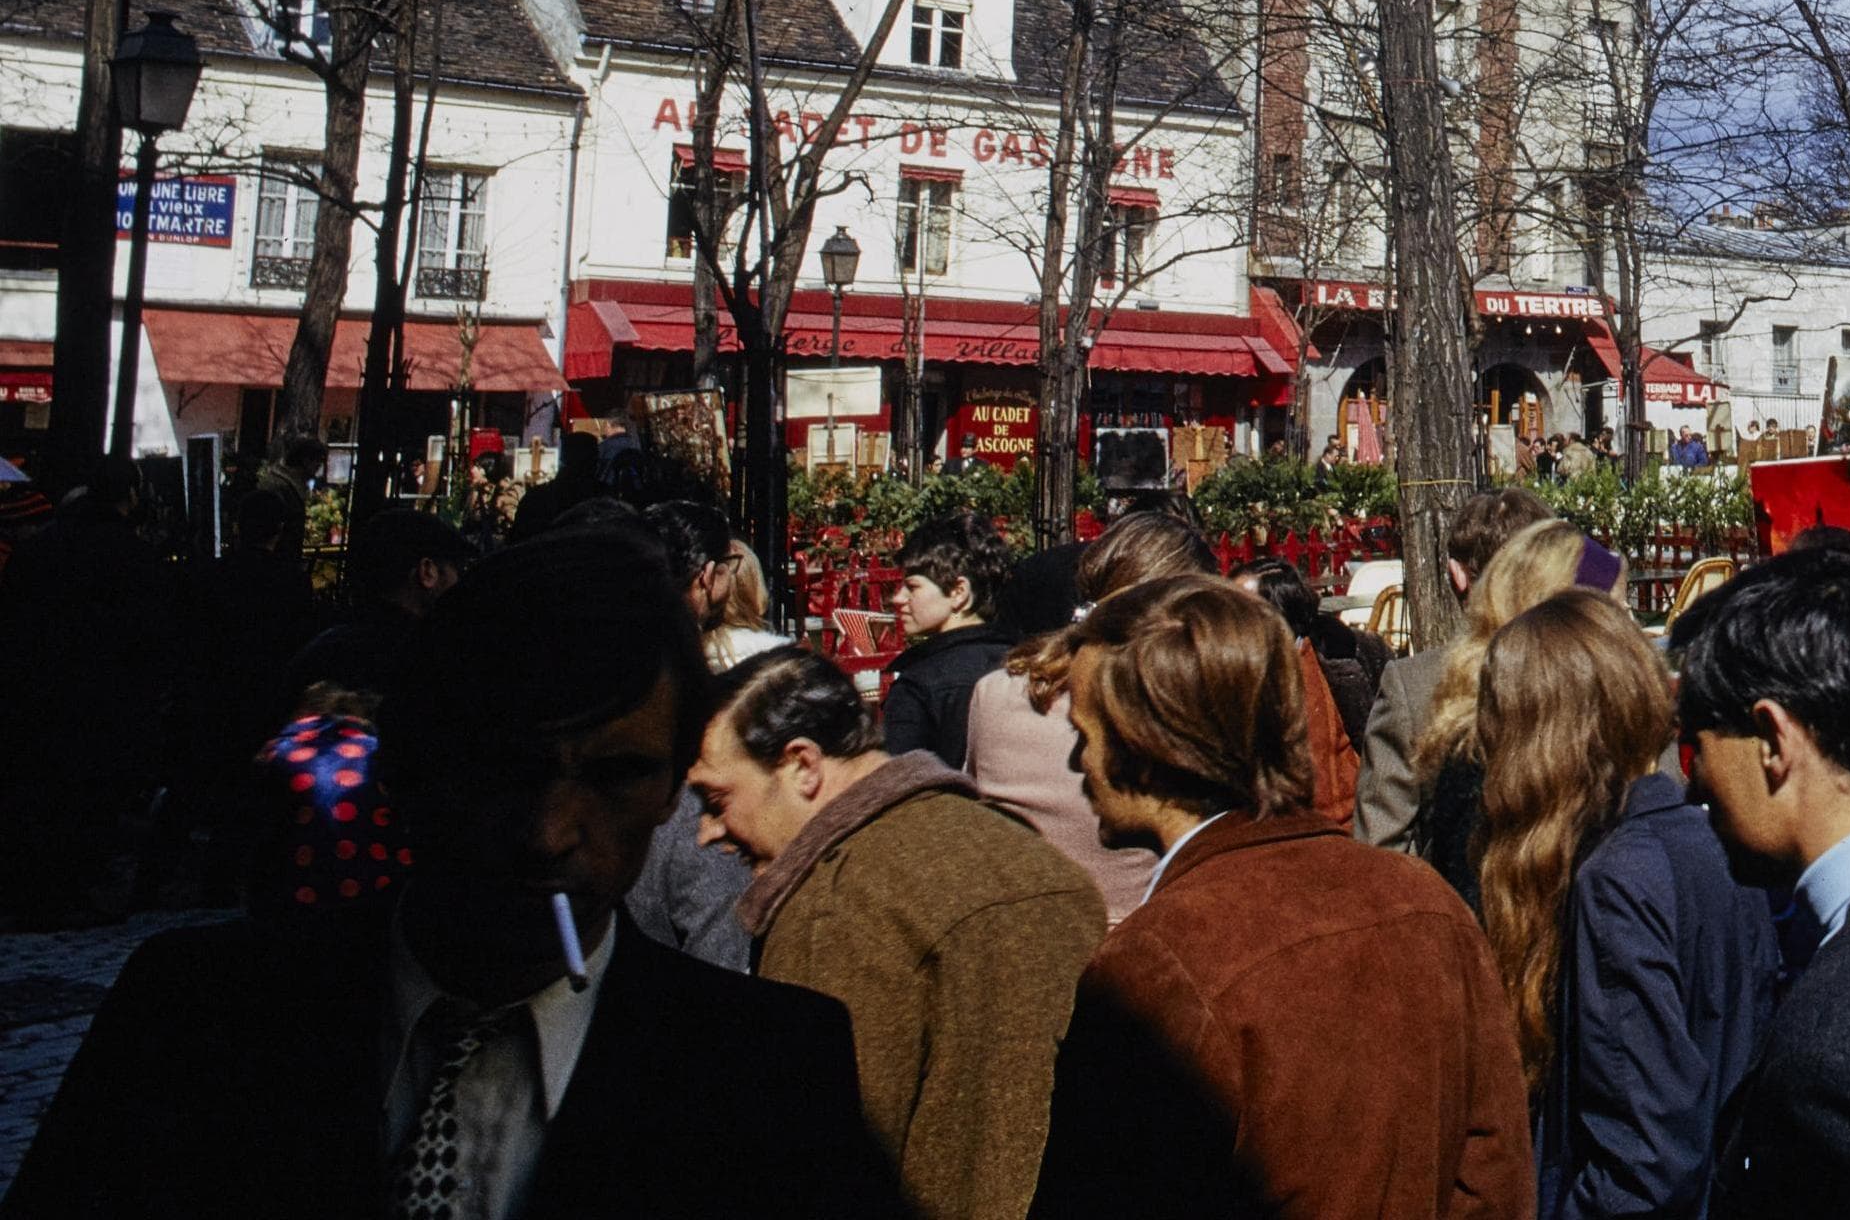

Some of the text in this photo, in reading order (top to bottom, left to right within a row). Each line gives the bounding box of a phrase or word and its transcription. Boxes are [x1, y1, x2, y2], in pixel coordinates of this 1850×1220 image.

[740, 107, 877, 150] ADET
[900, 123, 948, 158] DE
[973, 128, 1176, 179] GASGNE
[116, 212, 227, 235] OTMARTRE
[1317, 286, 1356, 307] LA
[1486, 295, 1604, 316] DU TERTRE
[972, 406, 1031, 423] AU CADET
[993, 424, 1009, 436] DE
[974, 437, 1035, 454] ASCOGNE
